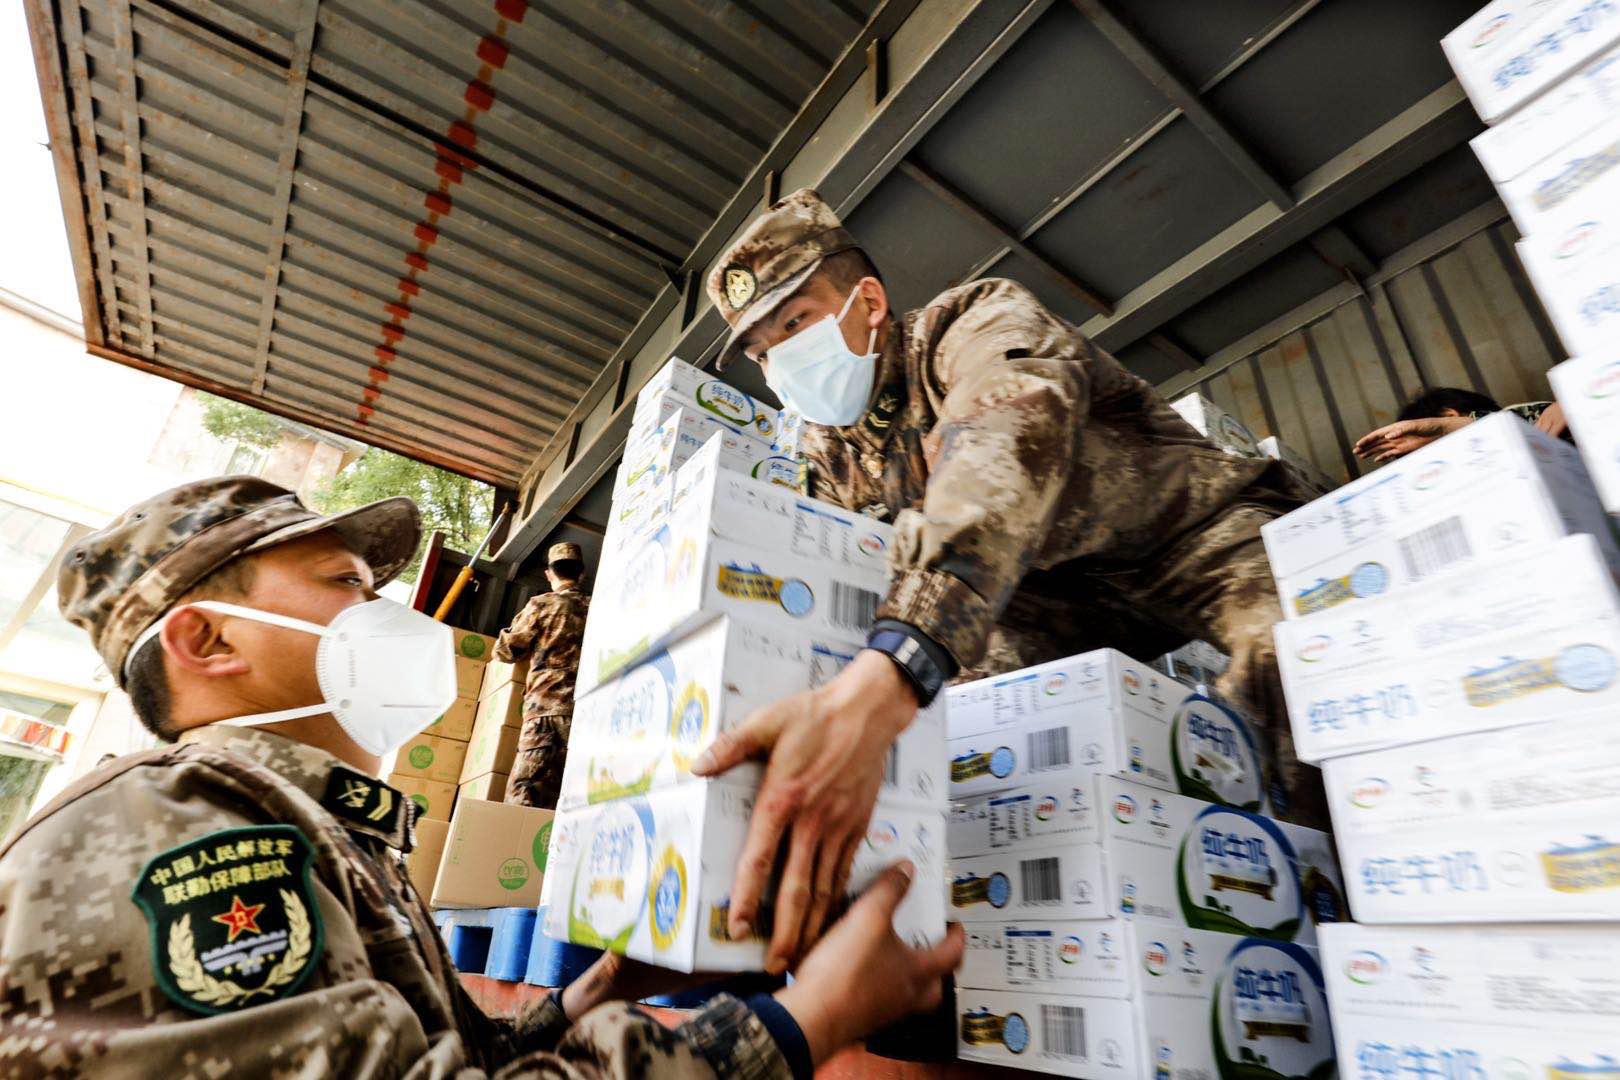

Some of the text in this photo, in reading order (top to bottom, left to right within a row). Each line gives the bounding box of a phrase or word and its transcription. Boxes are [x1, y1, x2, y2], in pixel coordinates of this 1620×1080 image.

[1308, 684, 1417, 733] 纯牛奶
[151, 839, 293, 885] 中国人民解放军
[1201, 825, 1272, 866] 纯牛奶
[162, 859, 292, 904] 联勤保障部队
[1360, 850, 1490, 896] 纯牛奶
[1233, 965, 1306, 1004] 纯牛奶
